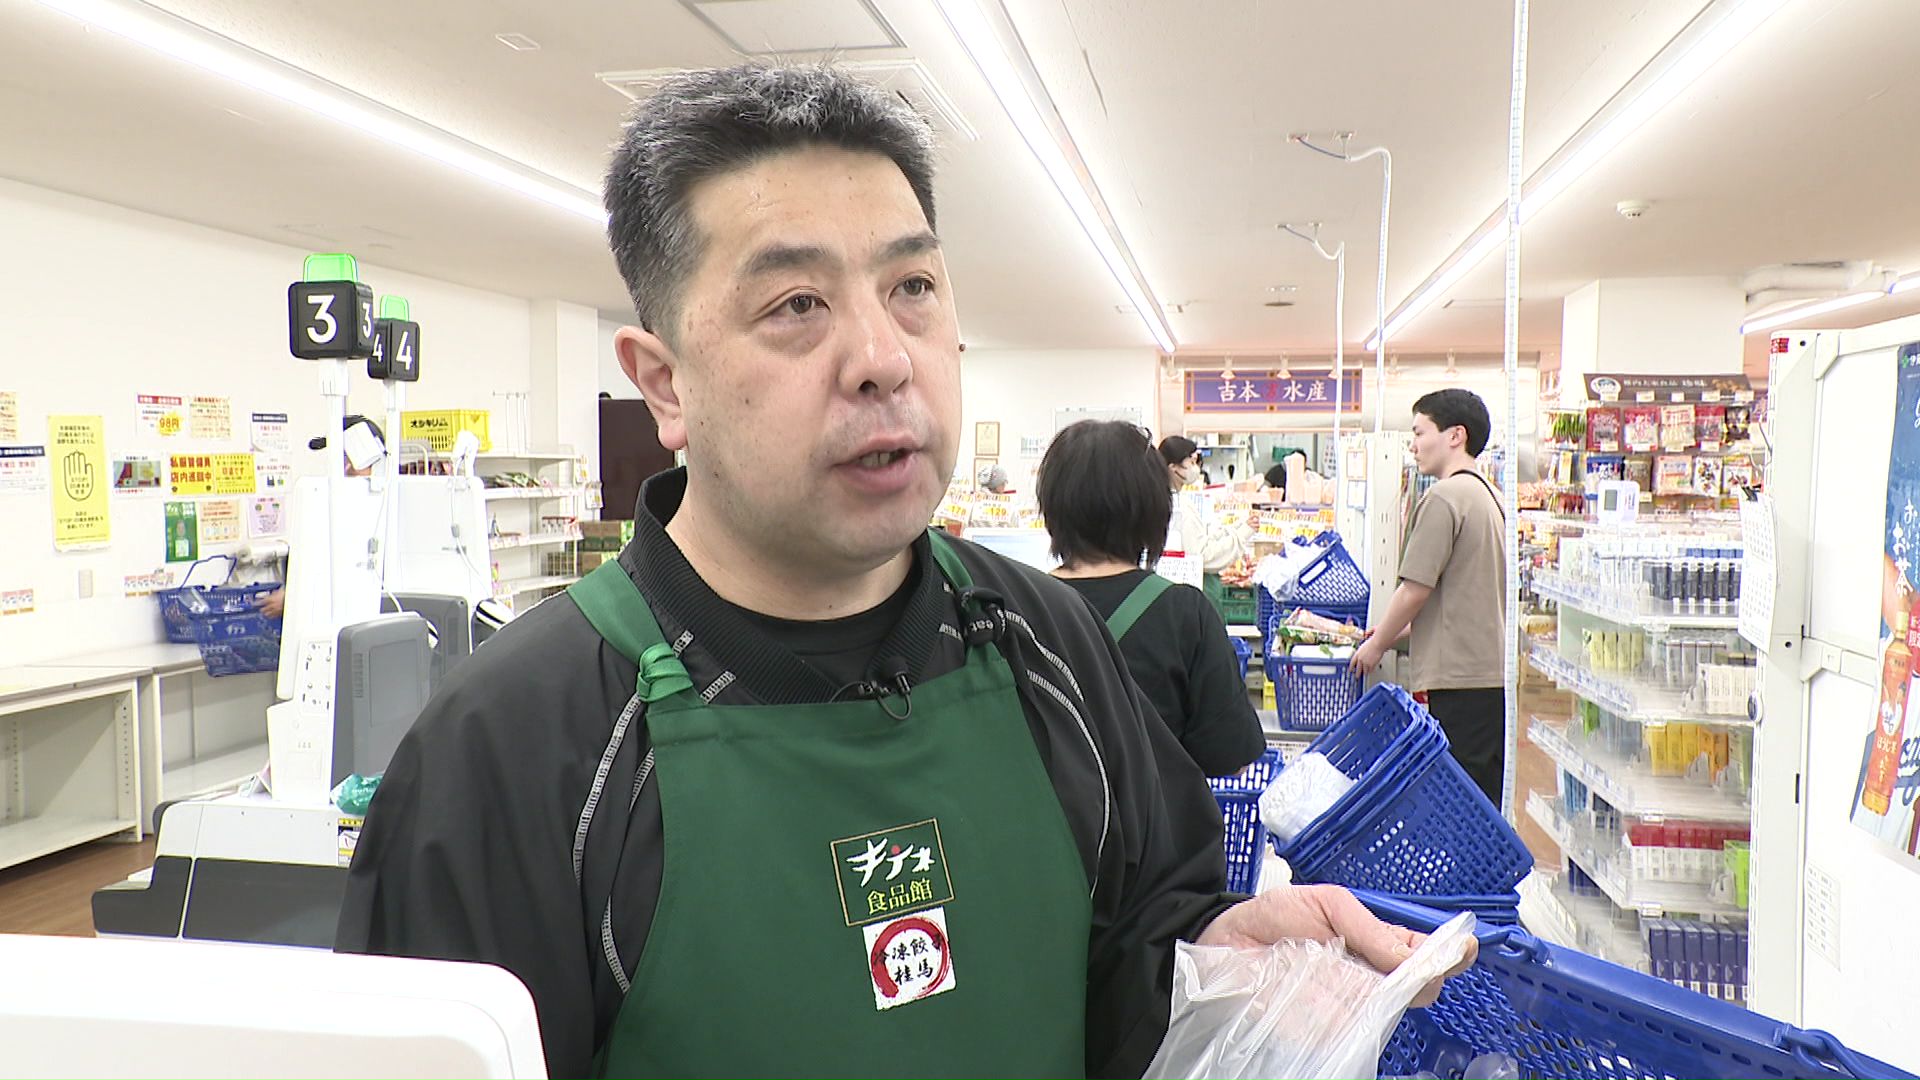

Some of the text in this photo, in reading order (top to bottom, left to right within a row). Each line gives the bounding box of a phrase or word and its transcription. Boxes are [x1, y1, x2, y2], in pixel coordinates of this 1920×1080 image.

[306, 294, 338, 343] 3
[362, 302, 372, 338] 3
[372, 333, 383, 362] 4
[396, 331, 412, 370] 4
[867, 878, 933, 915] 食品館
[874, 932, 944, 965] 冷凍餃子
[894, 958, 934, 985] 桂馬
